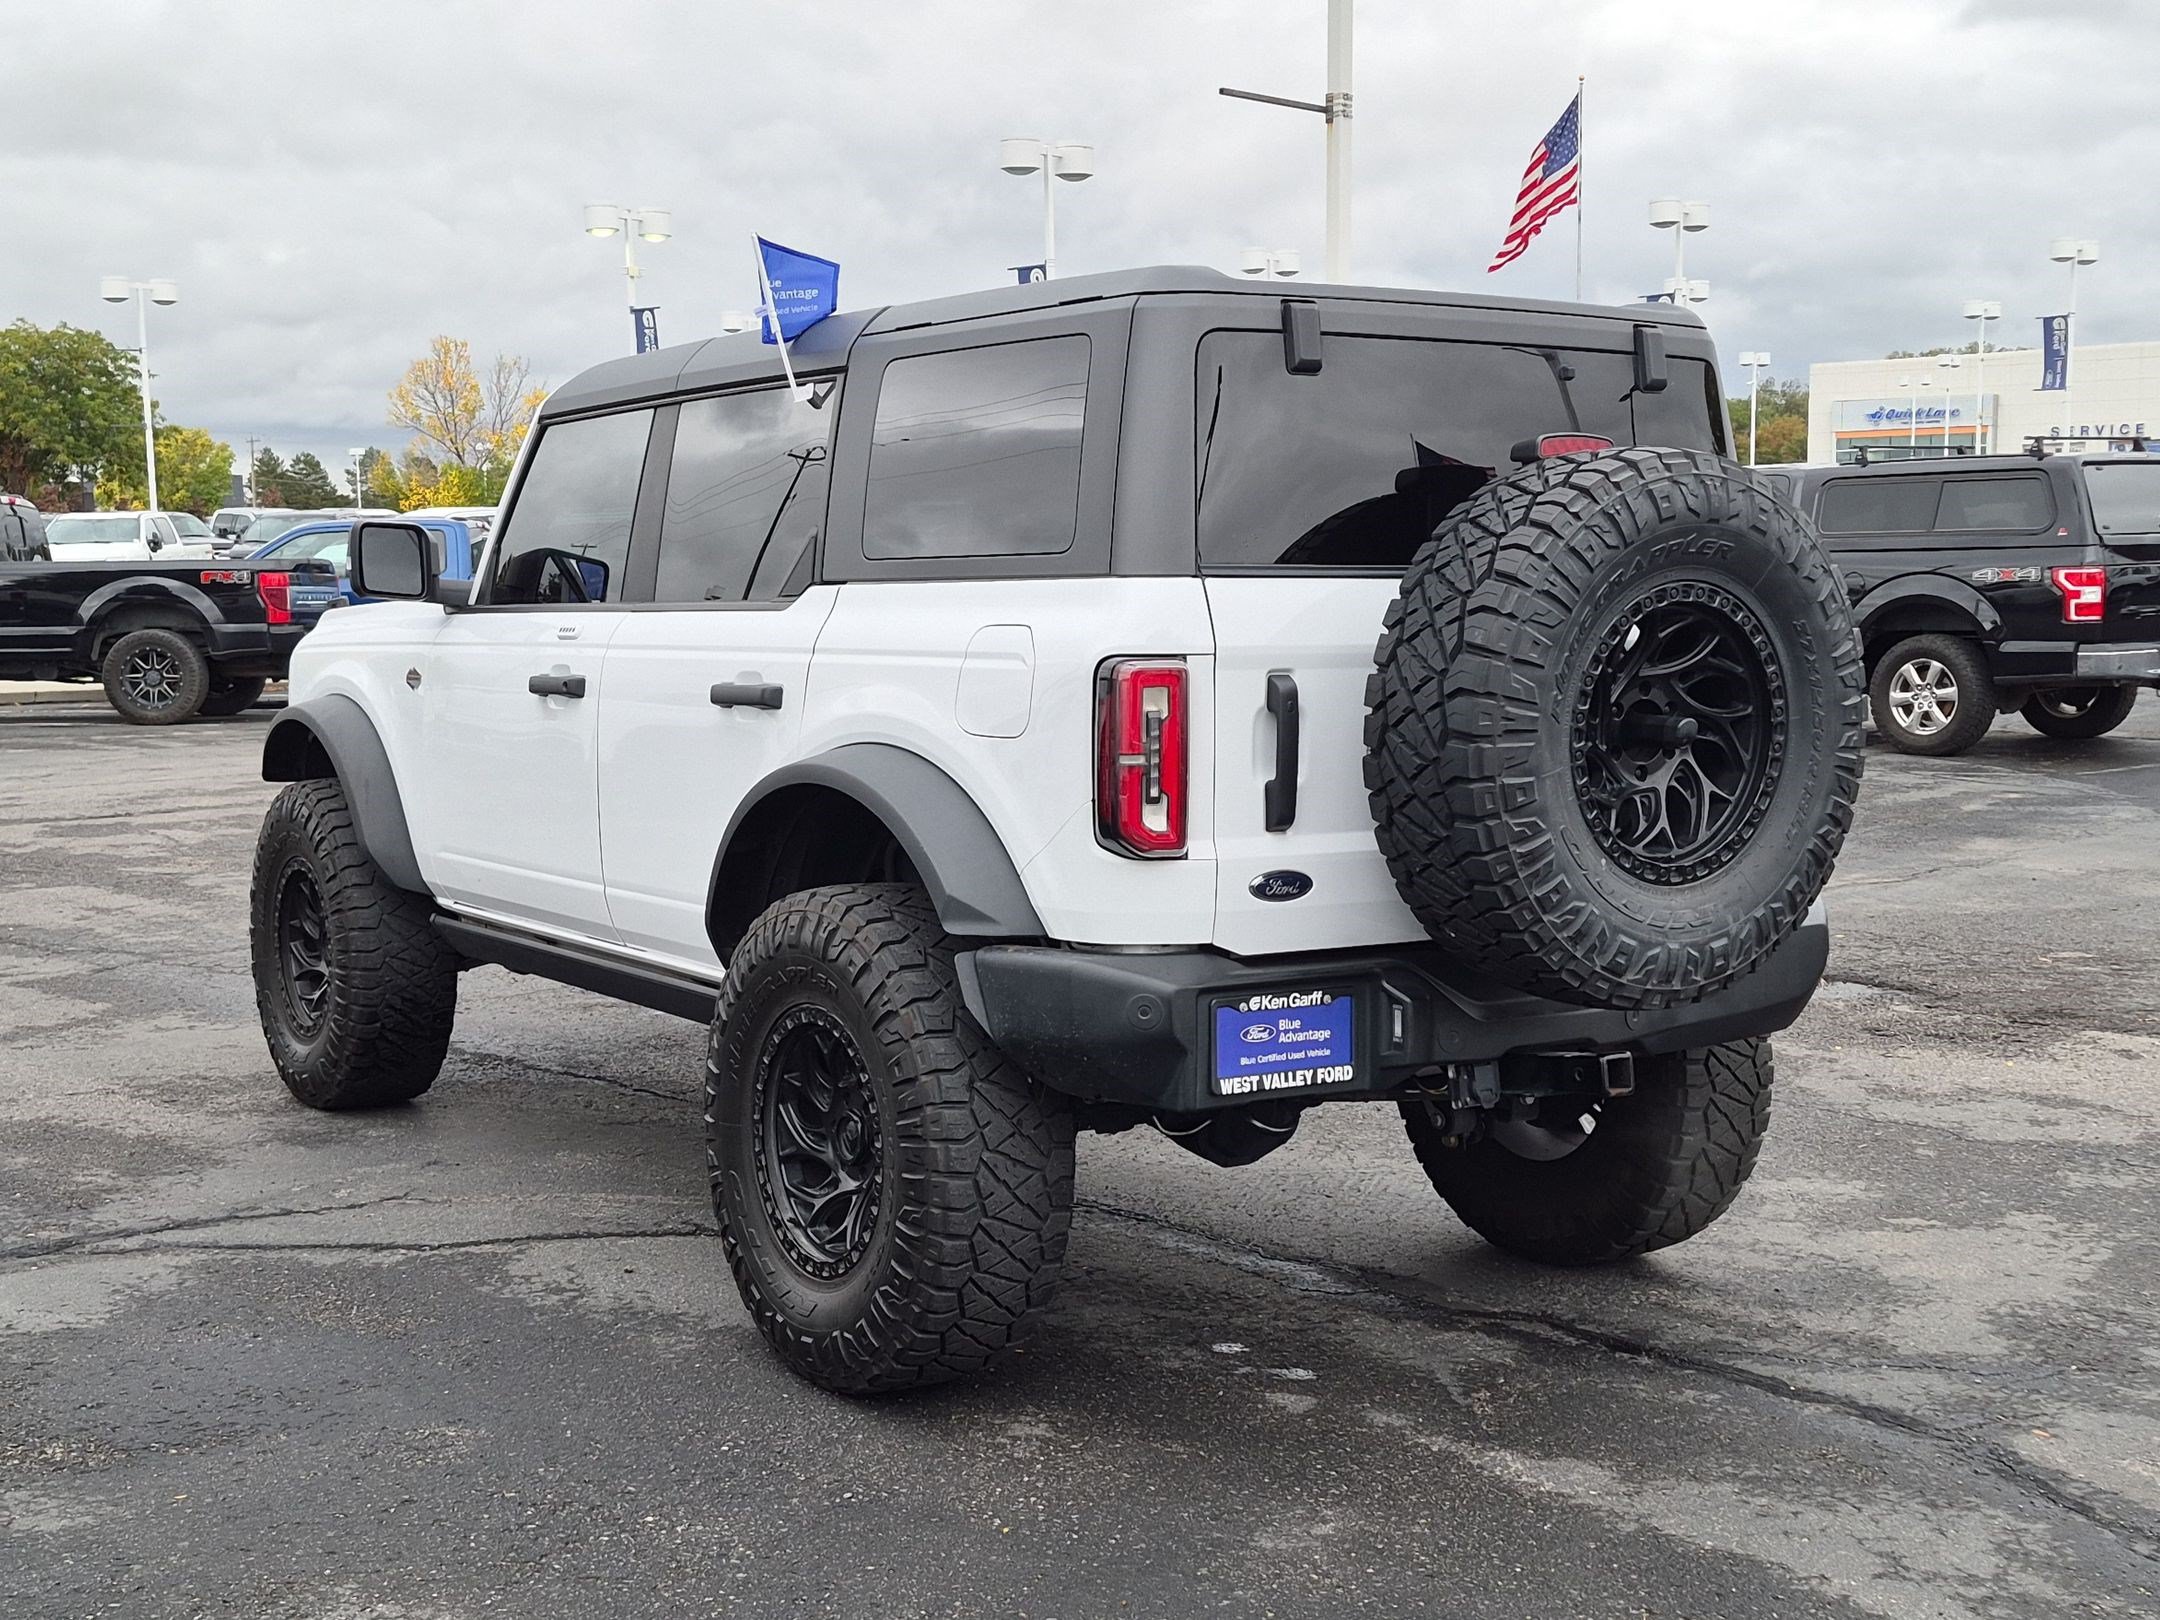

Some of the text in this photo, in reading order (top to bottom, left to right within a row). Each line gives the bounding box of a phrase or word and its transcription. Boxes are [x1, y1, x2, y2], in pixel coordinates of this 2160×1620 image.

[768, 280, 782, 288] ue
[773, 289, 819, 300] vantage
[2050, 423, 2145, 438] SERVICE
[200, 570, 251, 584] FX4
[1266, 878, 1300, 896] Ford
[1288, 991, 1323, 1008] Garff
[1278, 1018, 1302, 1031] Blue
[1246, 1027, 1270, 1040] Ford
[1278, 1029, 1332, 1044] Advantage
[1240, 1047, 1331, 1066] Blue Certified Used Vehicle
[1219, 1065, 1354, 1095] WEST VALLEY FORD
